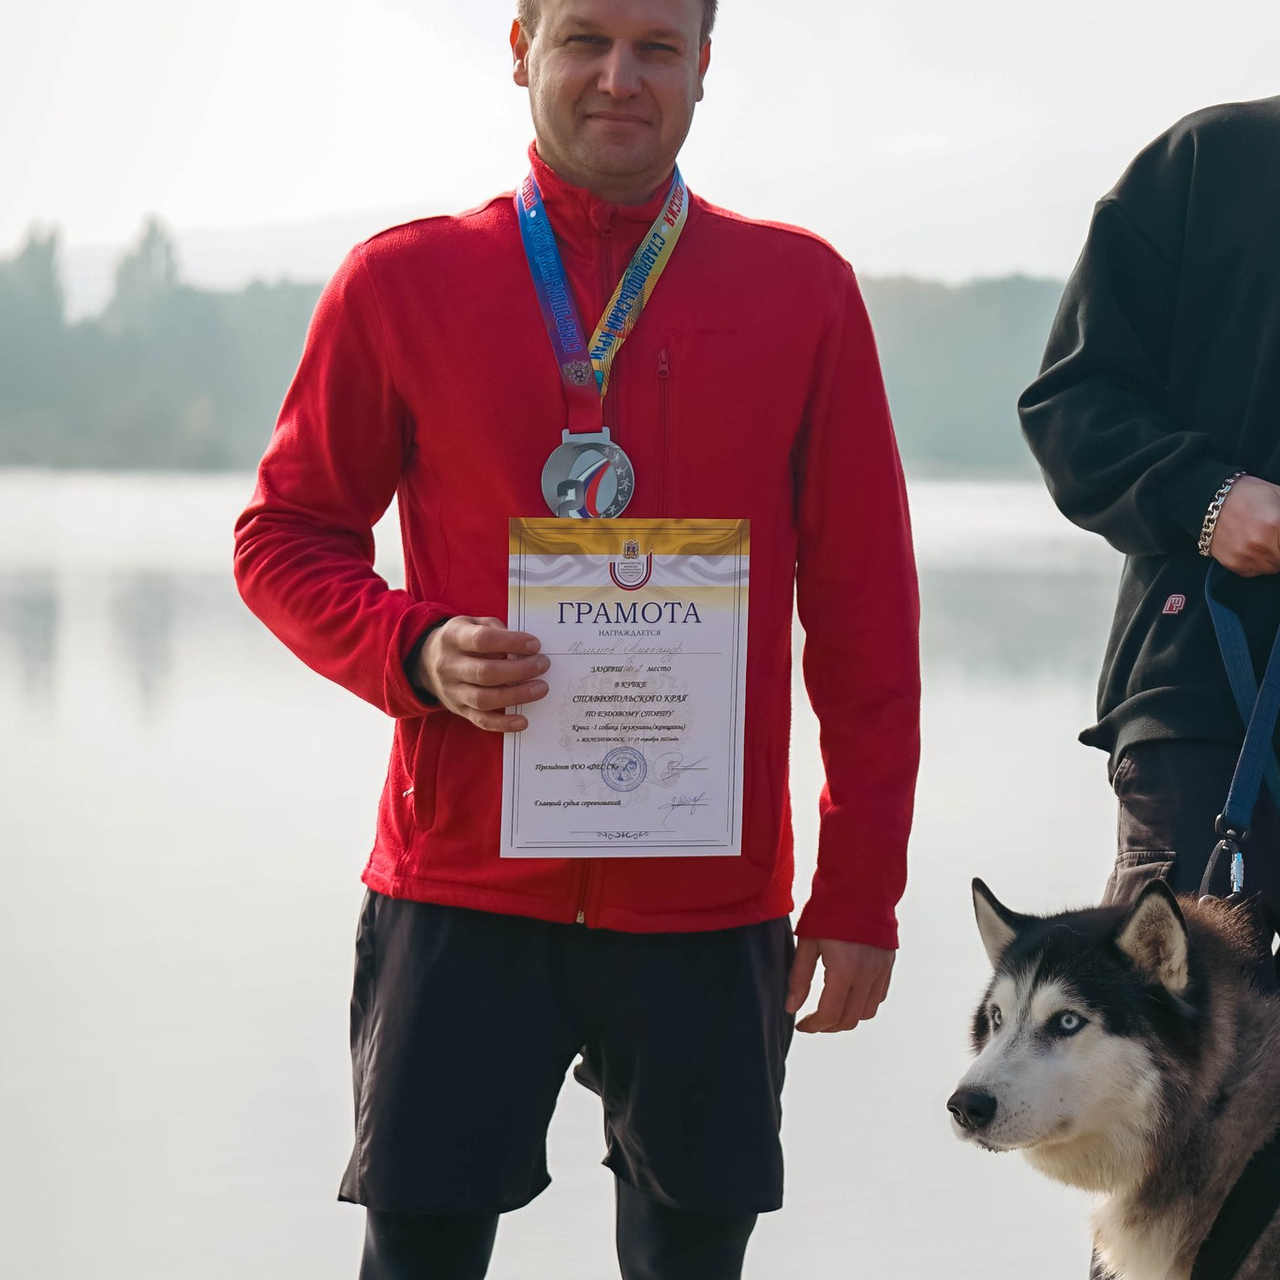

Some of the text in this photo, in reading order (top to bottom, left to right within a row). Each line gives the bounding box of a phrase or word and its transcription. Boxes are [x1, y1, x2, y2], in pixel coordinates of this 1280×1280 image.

[605, 232, 666, 332] СТАВРОПОЛЬСКИЙ
[557, 602, 702, 624] ГРАМОТА
[572, 694, 688, 703] СТАВРОПОЛЬСКОГО КРАЯ
